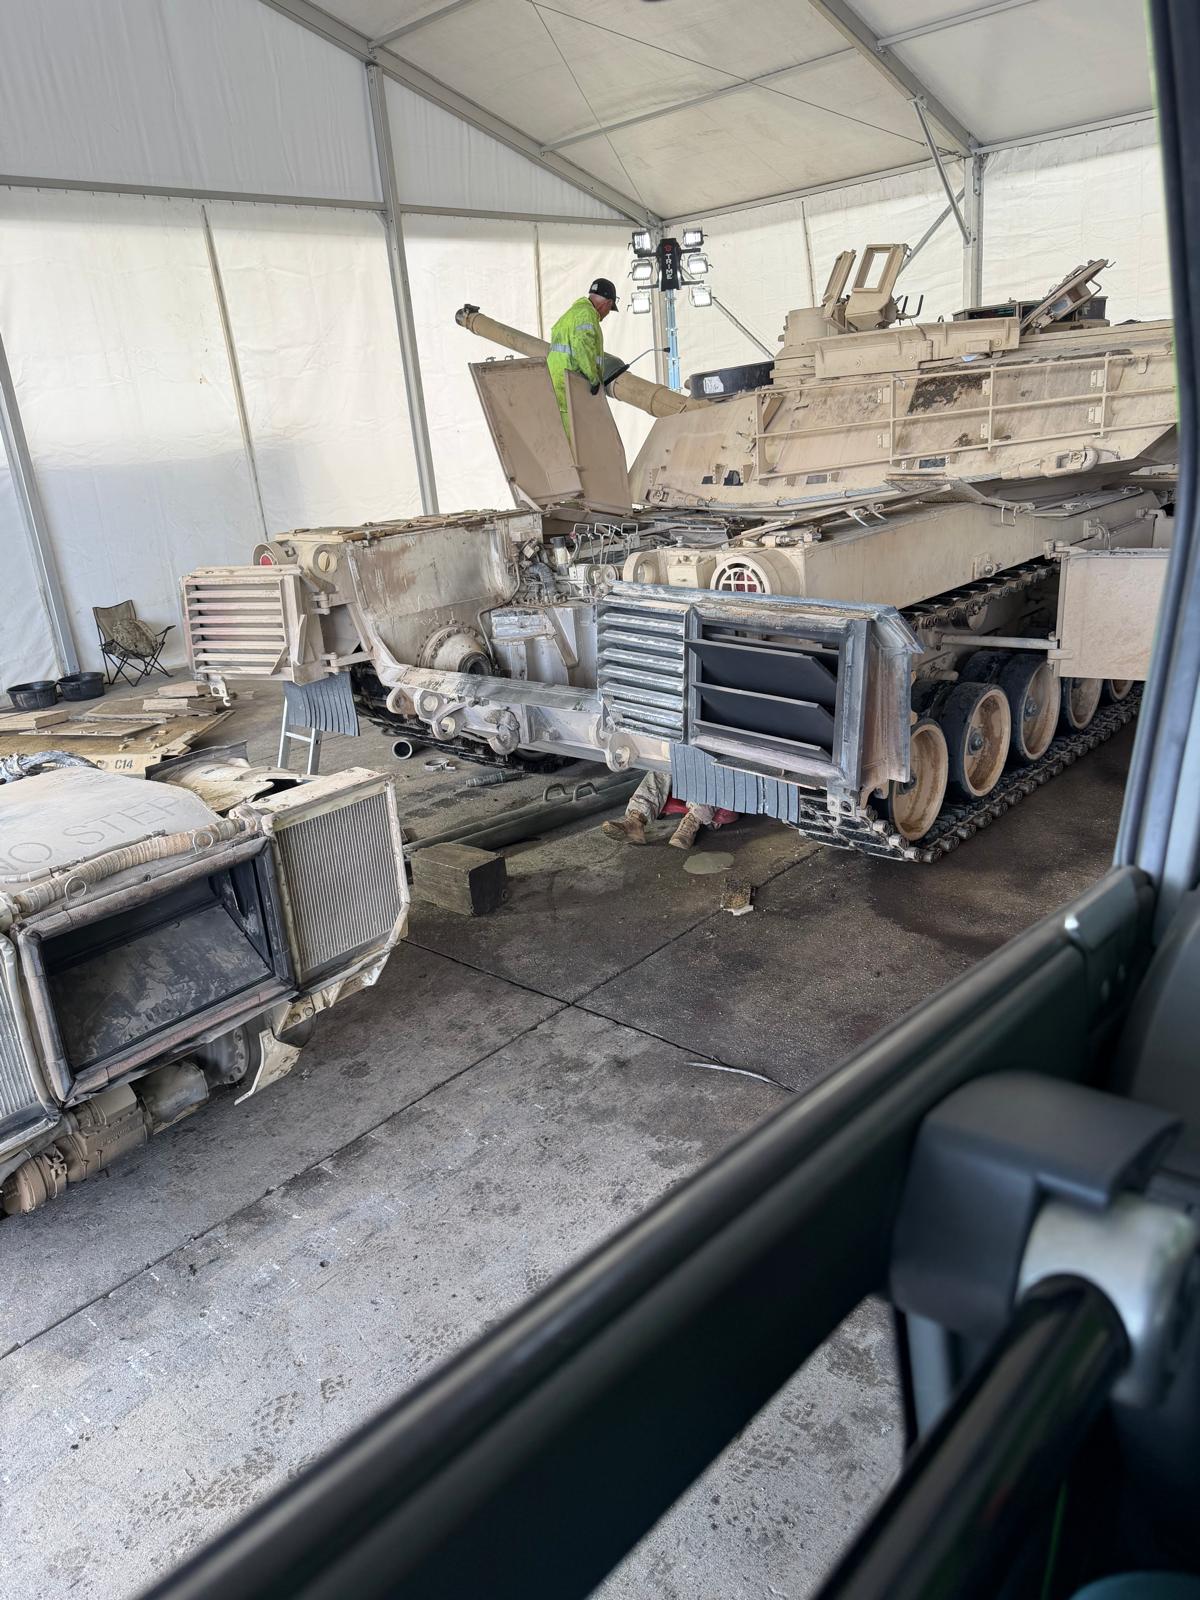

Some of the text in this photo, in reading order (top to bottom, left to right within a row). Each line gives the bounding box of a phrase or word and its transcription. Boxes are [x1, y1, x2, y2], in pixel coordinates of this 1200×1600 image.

[665, 253, 673, 280] TRIME
[114, 760, 133, 769] C14
[63, 796, 180, 844] STEP
